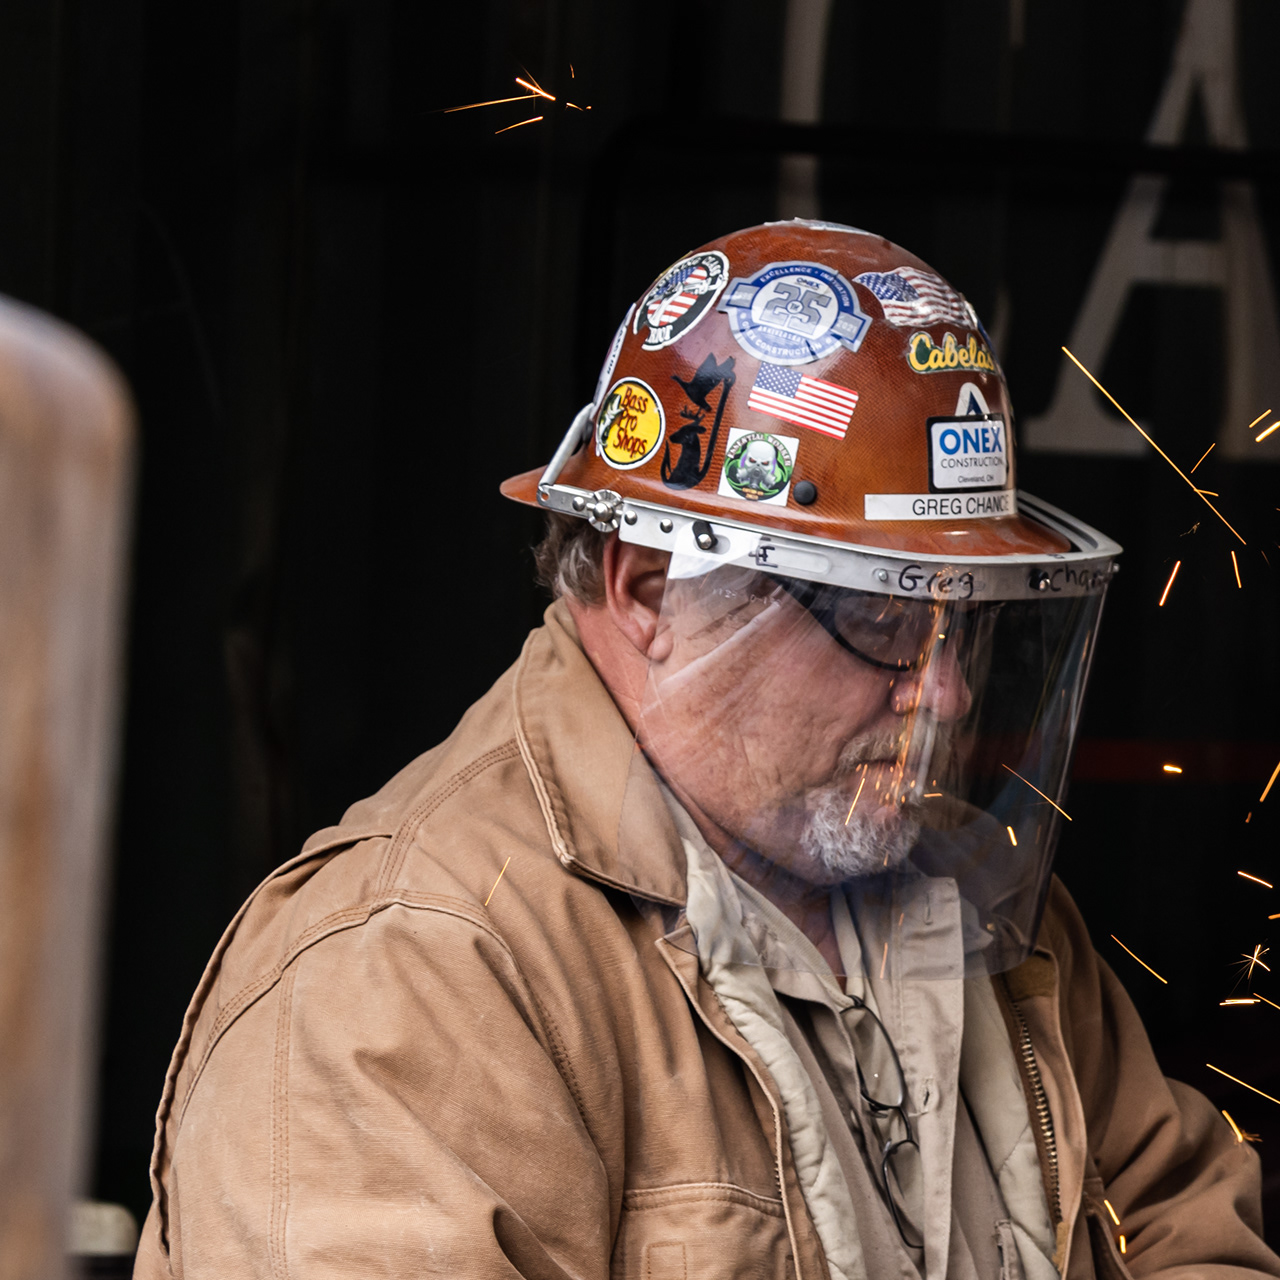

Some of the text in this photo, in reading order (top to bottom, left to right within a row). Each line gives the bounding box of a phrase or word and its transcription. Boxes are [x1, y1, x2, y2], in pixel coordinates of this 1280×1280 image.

[701, 255, 722, 277] CLASS
[759, 266, 813, 283] EXCELLENCE
[759, 281, 832, 336] 25
[620, 385, 649, 414] Bass
[617, 409, 638, 431] Pro
[612, 428, 648, 459] Shops
[727, 433, 792, 466] ESSENTIAL WORKER
[939, 427, 1003, 456] ONEX
[940, 456, 1004, 469] CONSTRUCTION
[912, 498, 962, 516] GREG
[898, 563, 975, 600] Greg
